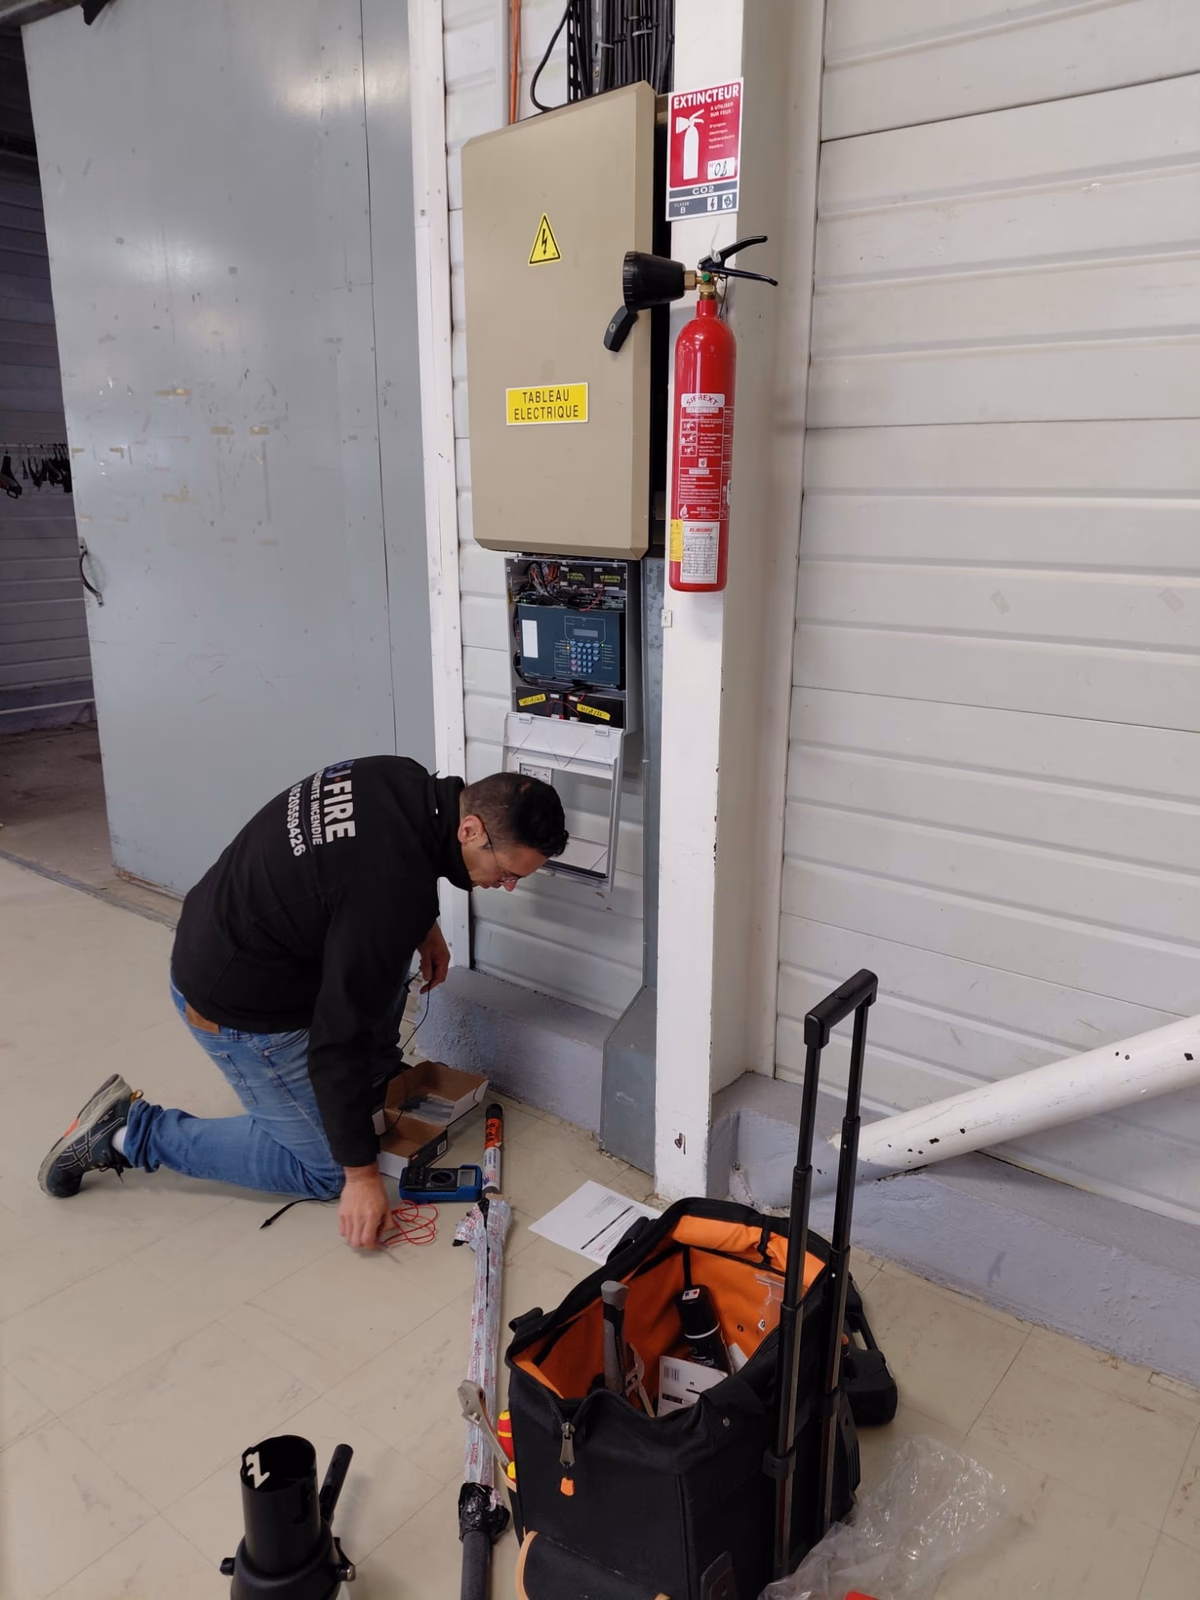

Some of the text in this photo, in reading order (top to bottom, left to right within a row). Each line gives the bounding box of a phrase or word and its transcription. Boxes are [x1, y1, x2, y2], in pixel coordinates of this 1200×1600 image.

[673, 84, 739, 110] EXTINCTEUR
[692, 185, 715, 195] CO2
[522, 388, 570, 404] TABLEAU
[514, 404, 579, 421] ELECTRIQUE
[310, 800, 323, 845] INCENDIE
